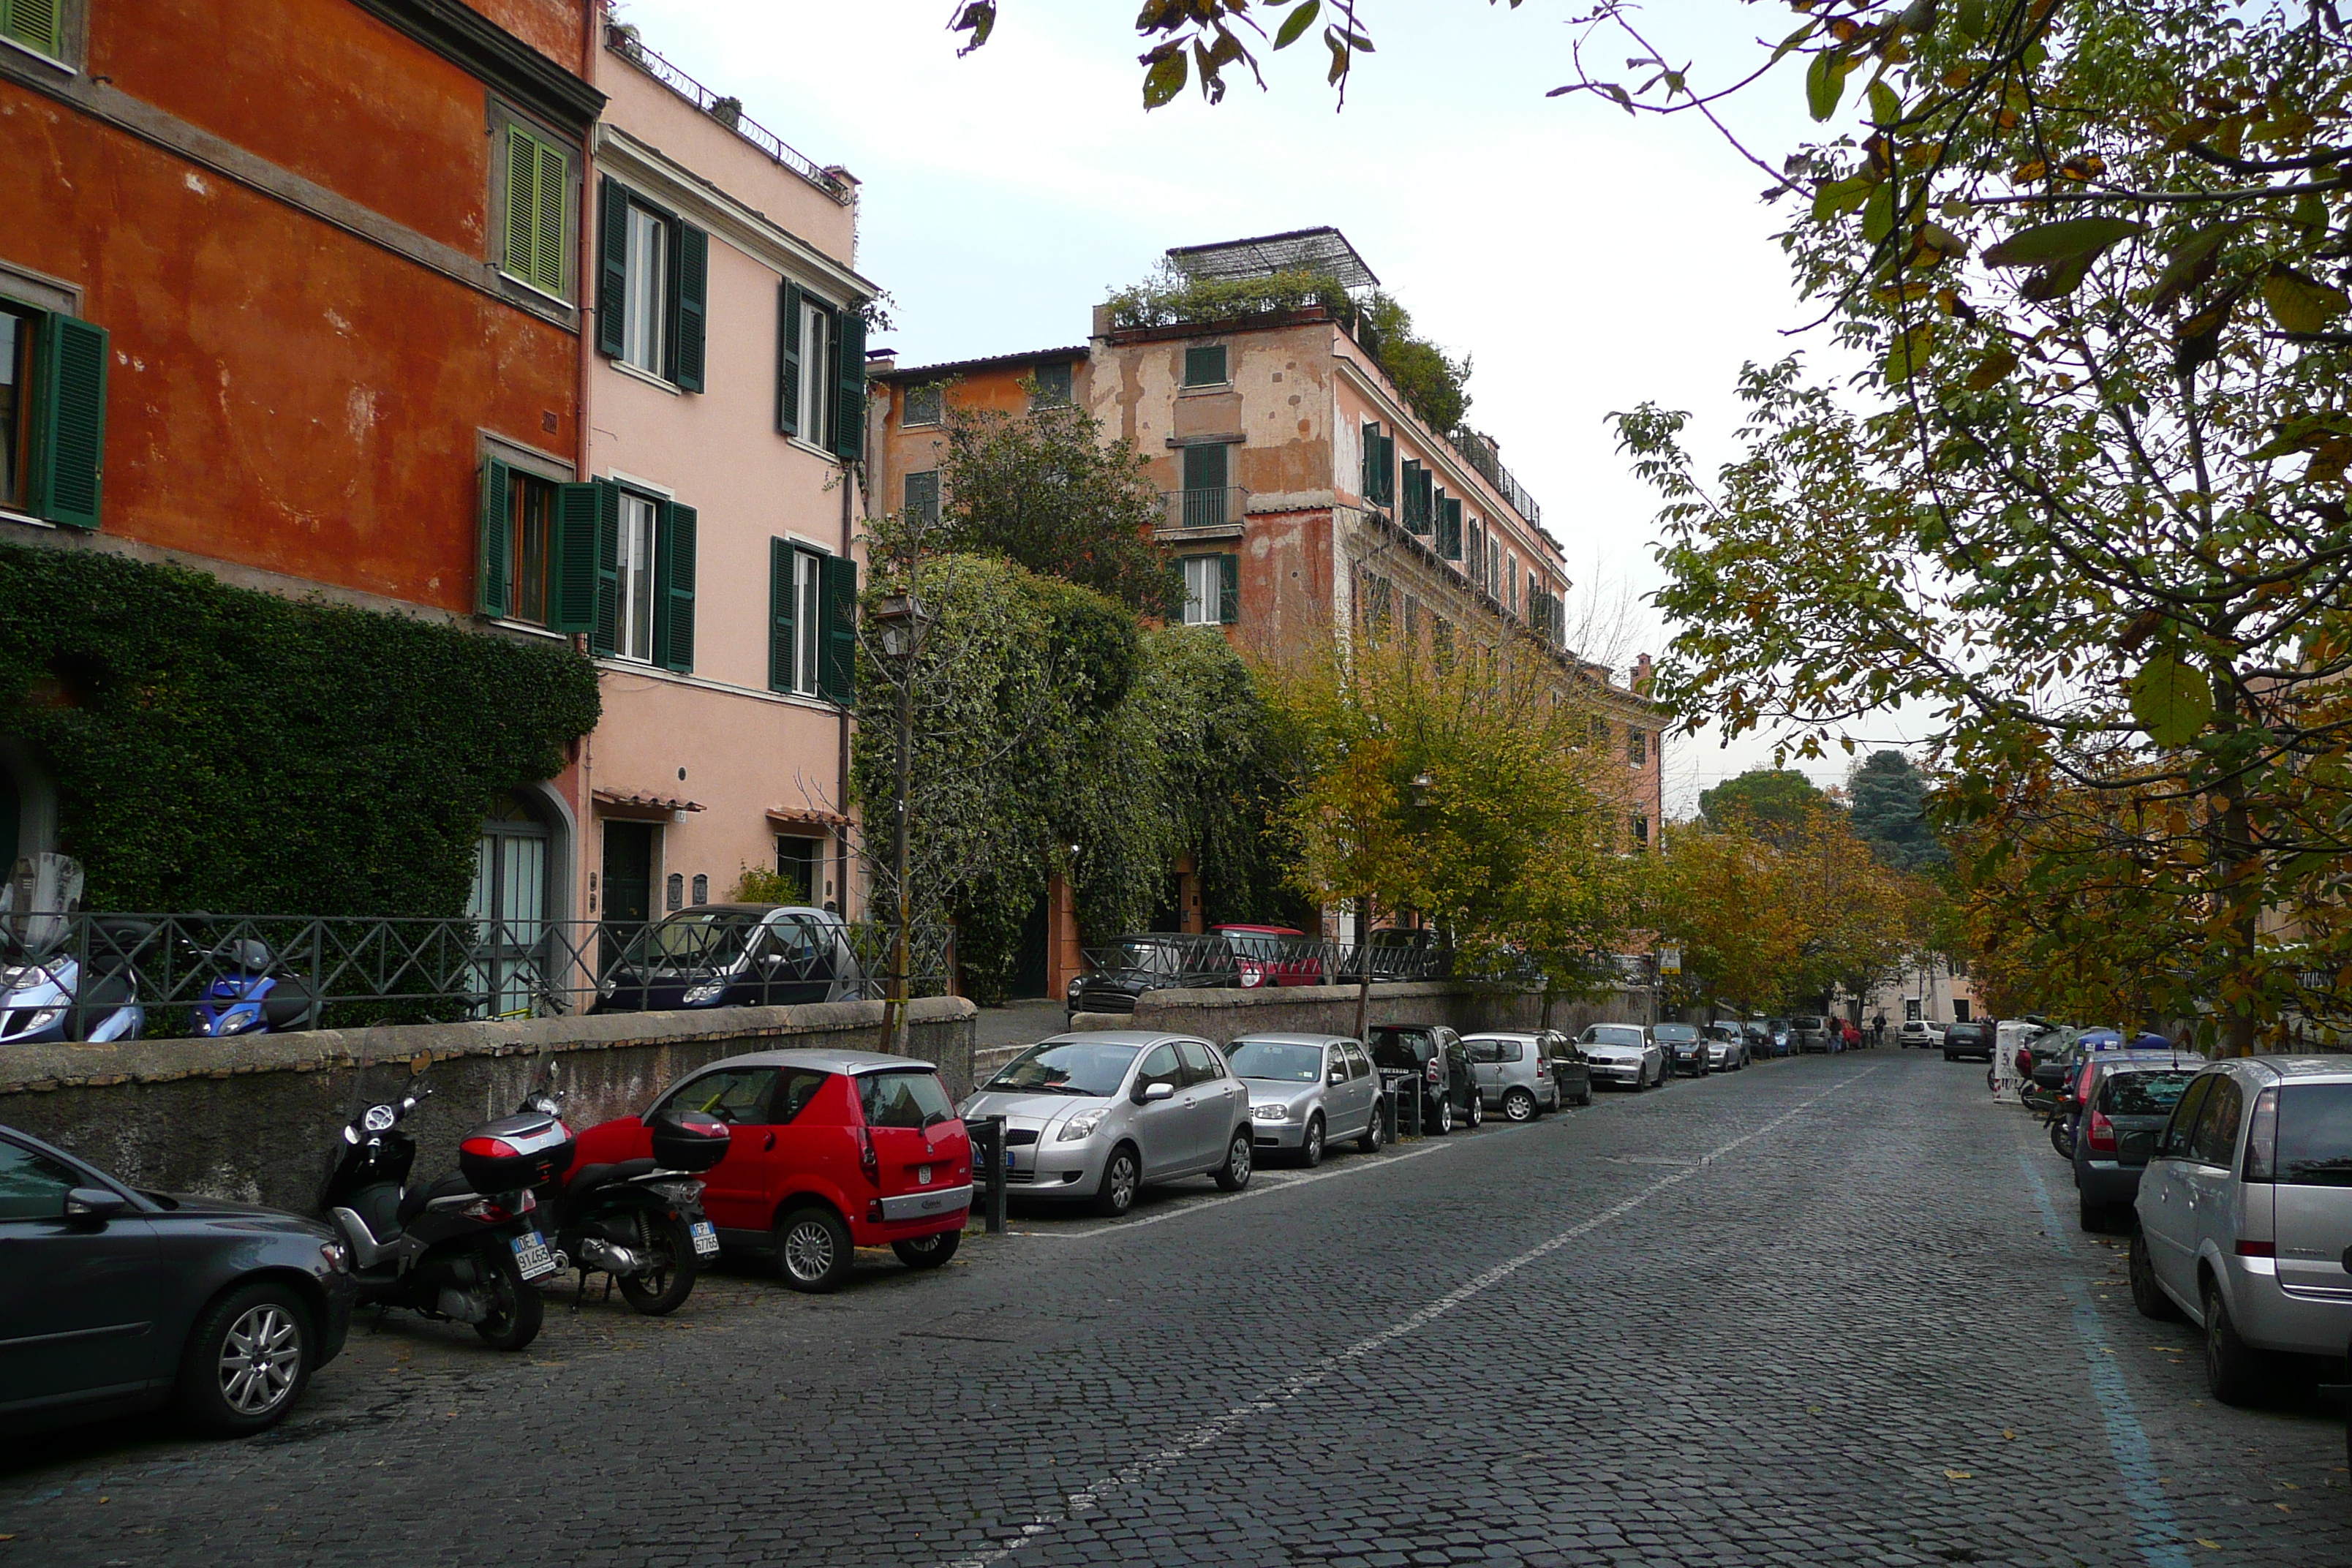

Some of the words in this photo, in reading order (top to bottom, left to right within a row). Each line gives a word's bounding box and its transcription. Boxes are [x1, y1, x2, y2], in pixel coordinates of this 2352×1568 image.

[696, 1224, 704, 1235] CP
[518, 1235, 532, 1251] DE
[696, 1236, 717, 1251] 67765
[519, 1247, 549, 1268] 91463
